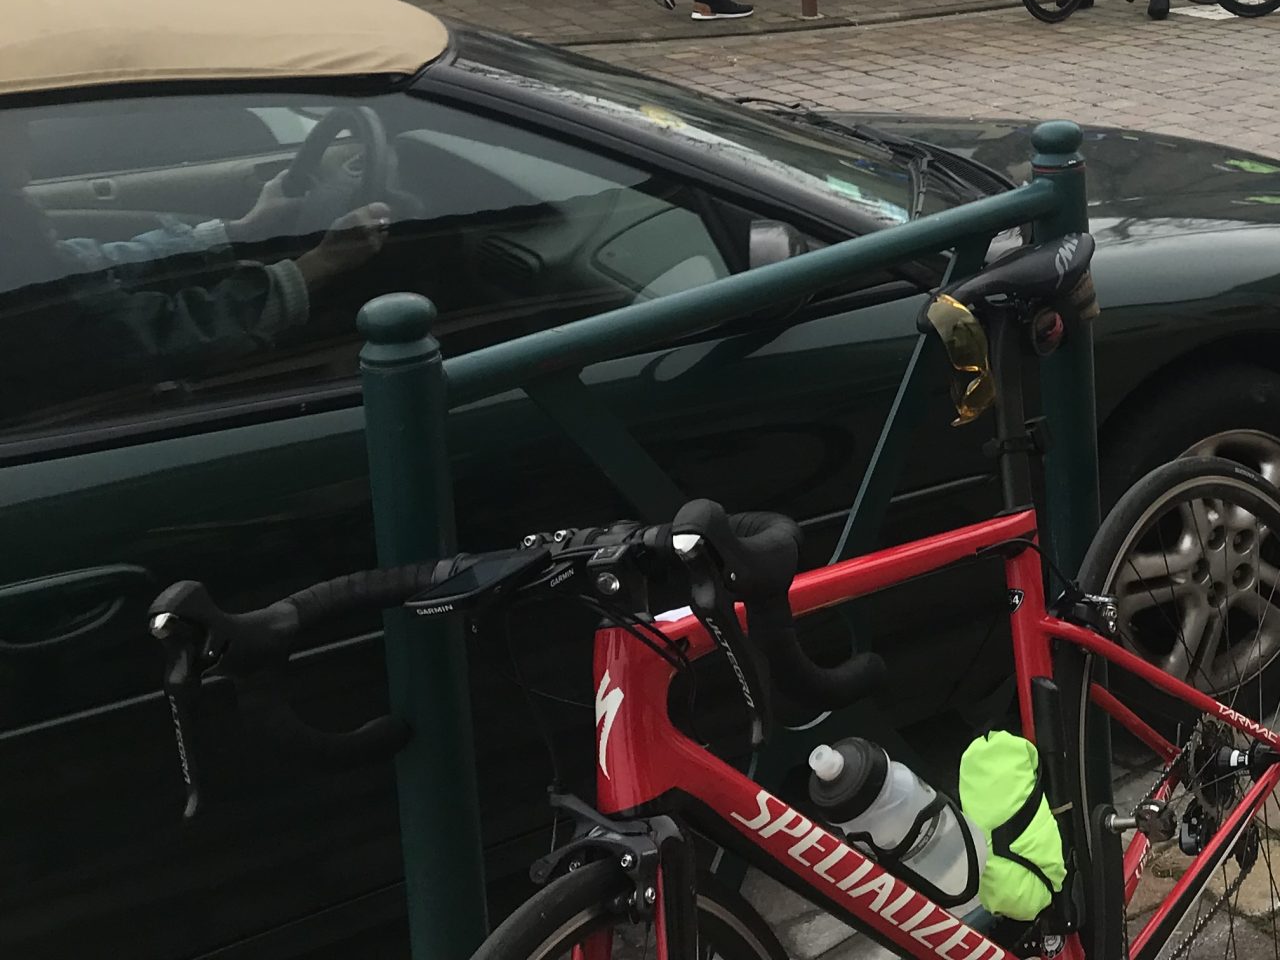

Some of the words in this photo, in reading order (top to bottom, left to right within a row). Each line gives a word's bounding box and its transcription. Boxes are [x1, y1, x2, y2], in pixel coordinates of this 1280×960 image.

[550, 568, 575, 588] GARMIN
[416, 604, 453, 616] GARMIN
[706, 617, 755, 708] ULTEGRA
[1215, 701, 1279, 744] TARMAC
